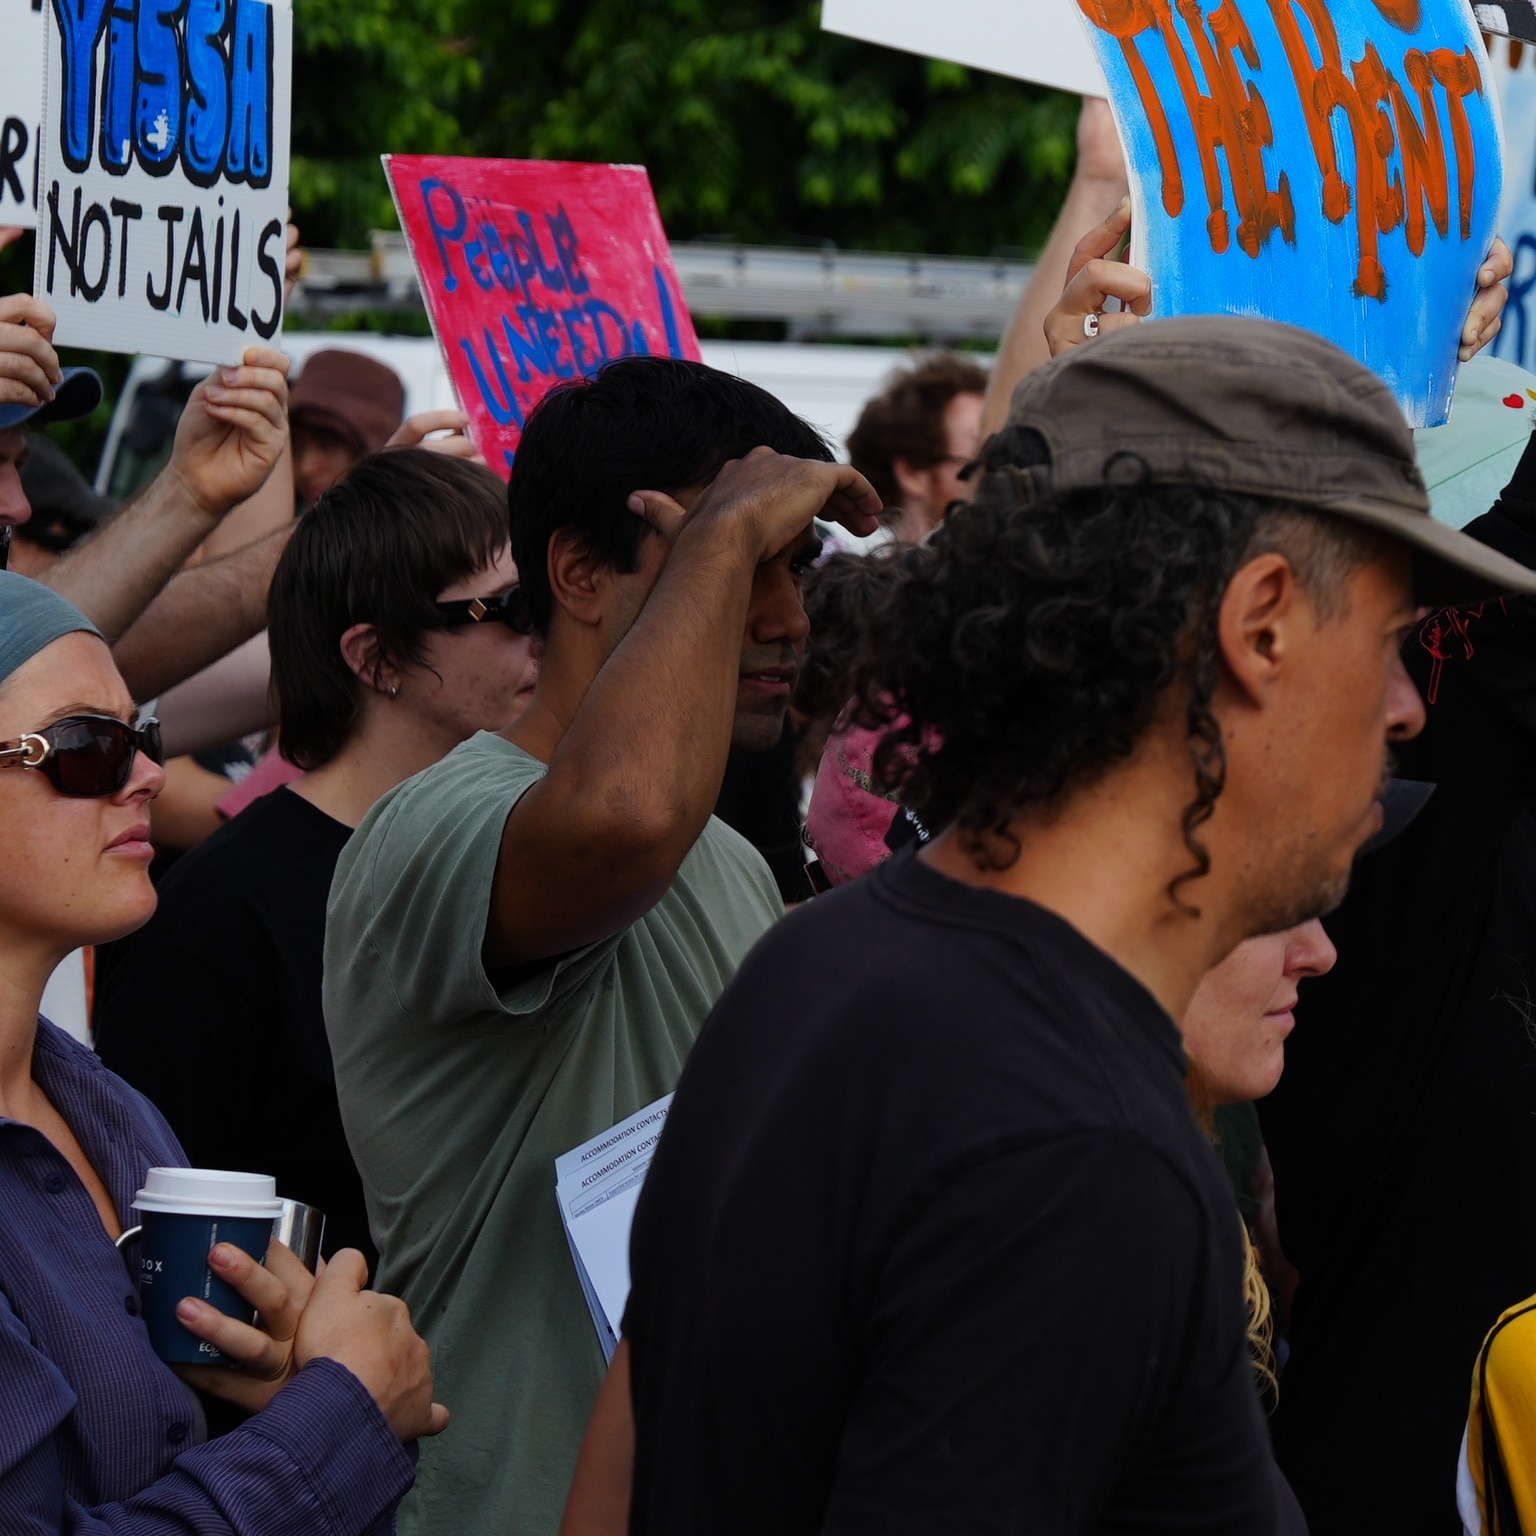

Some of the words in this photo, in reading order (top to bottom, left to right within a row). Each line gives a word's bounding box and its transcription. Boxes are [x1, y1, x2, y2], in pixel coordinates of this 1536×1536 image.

[47, 180, 143, 303] NOT
[581, 1126, 636, 1163] ACCOMMODATION
[582, 1149, 637, 1189] ACCOMMODATION
